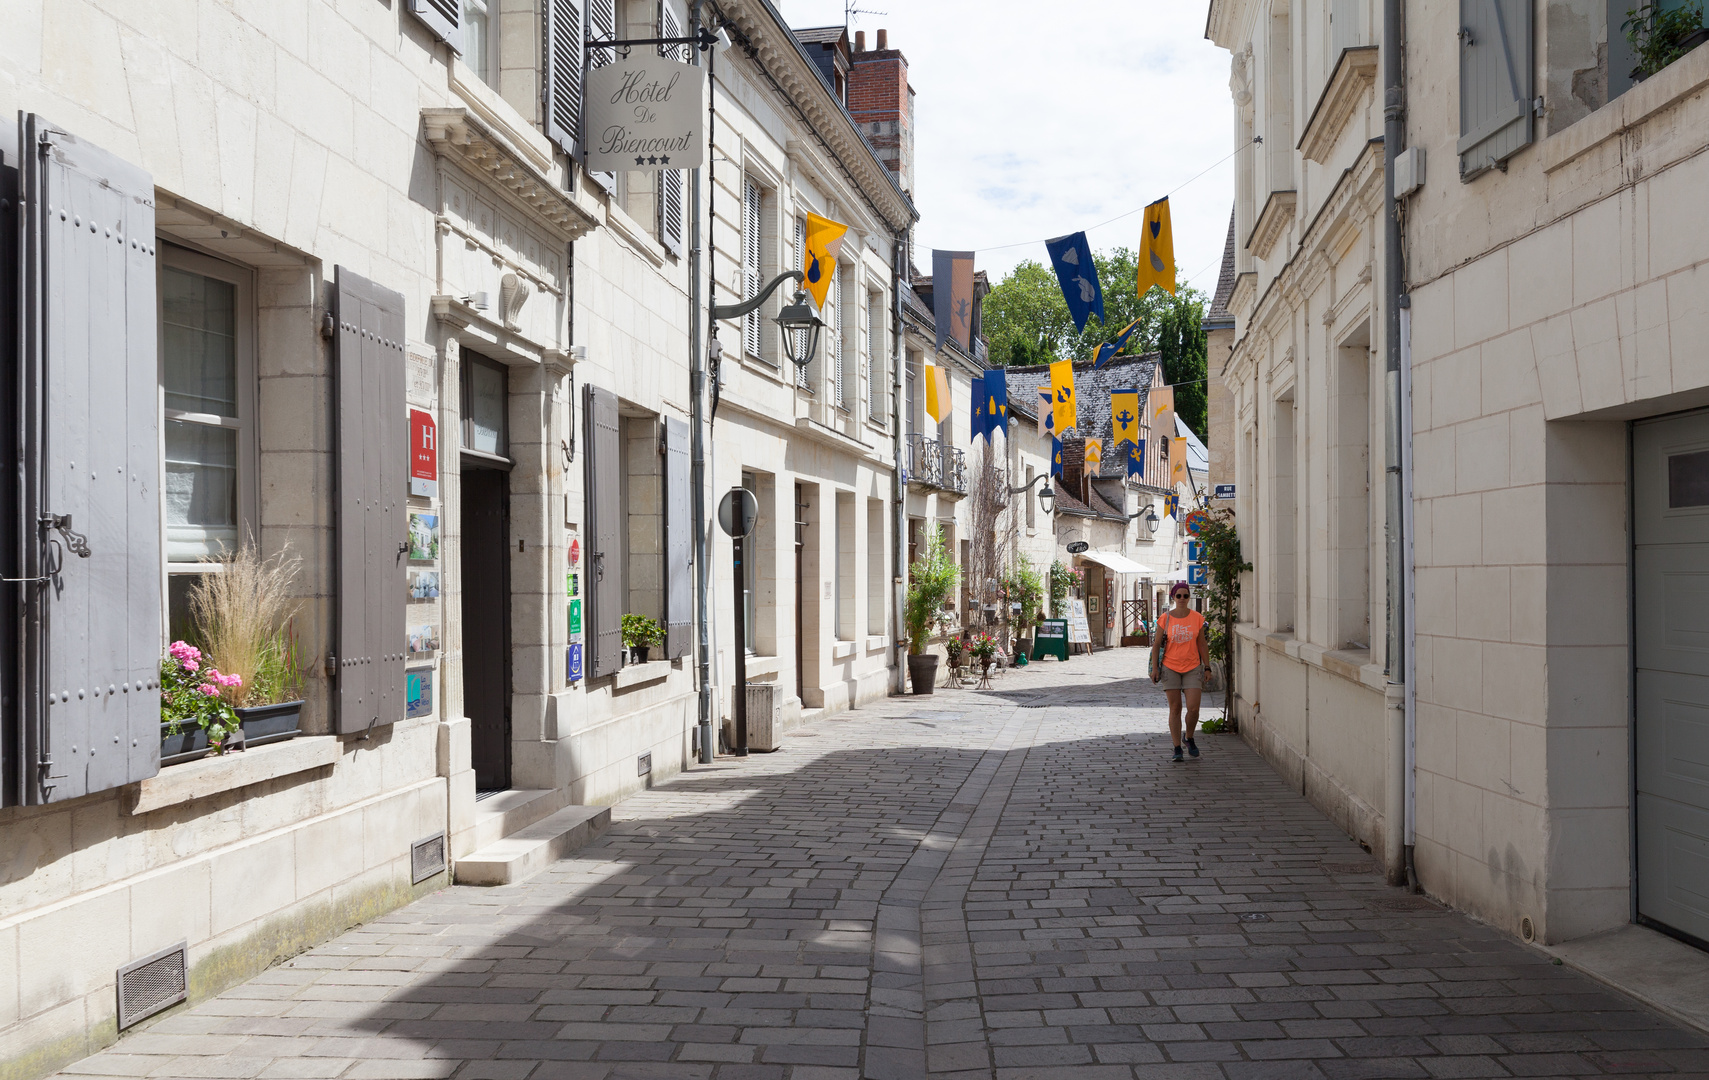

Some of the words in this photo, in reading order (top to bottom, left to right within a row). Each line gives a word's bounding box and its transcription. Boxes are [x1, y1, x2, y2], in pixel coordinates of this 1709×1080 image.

[610, 69, 681, 105] Hôtel
[633, 105, 657, 124] De
[598, 125, 693, 154] Biencourt
[422, 425, 434, 450] H
[1193, 568, 1204, 582] P
